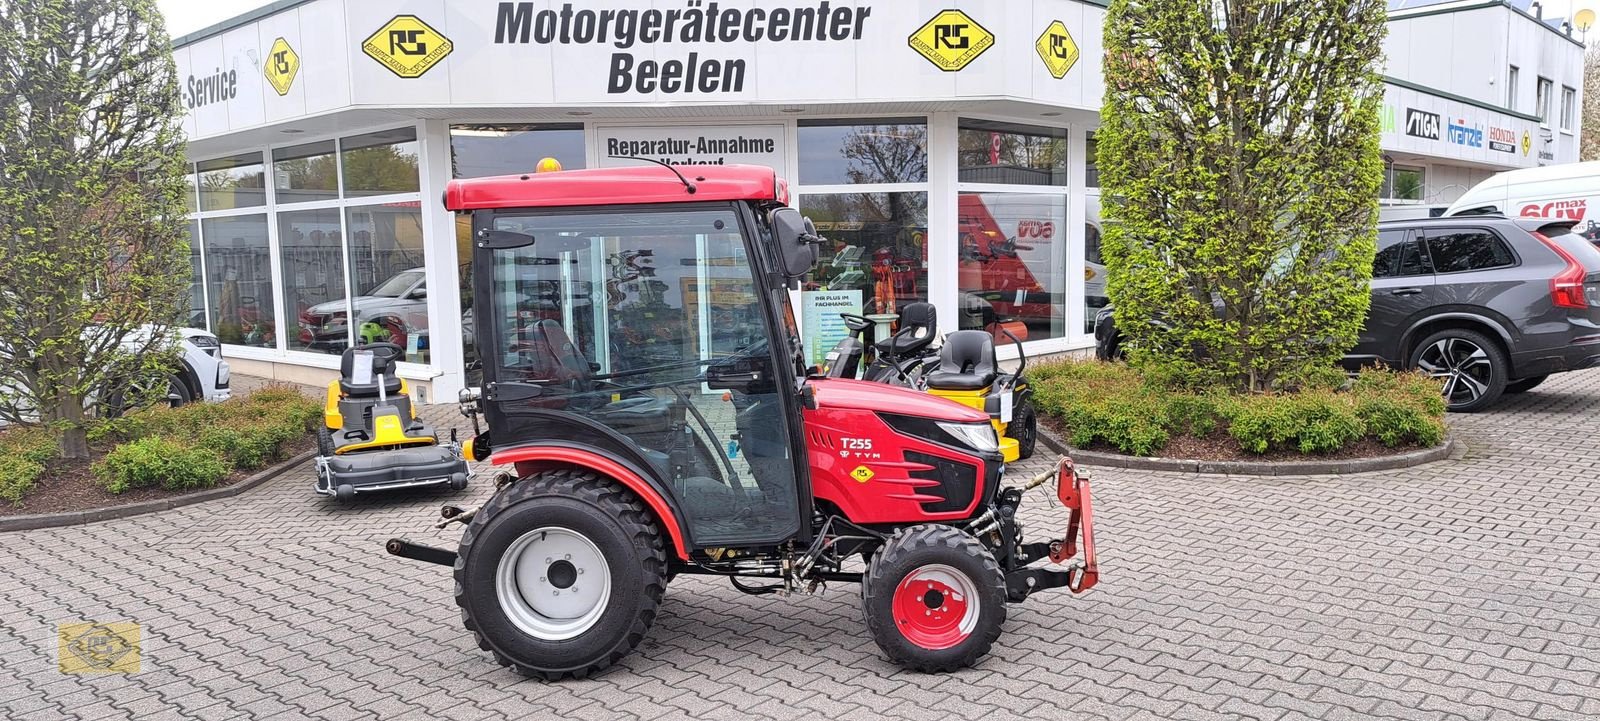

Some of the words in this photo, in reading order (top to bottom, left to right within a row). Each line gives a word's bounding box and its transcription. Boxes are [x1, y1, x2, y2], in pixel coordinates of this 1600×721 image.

[494, 0, 871, 48] Motorgerätecenter
[607, 52, 746, 94] Beelen
[182, 67, 237, 109] -Service
[1407, 110, 1439, 139] STIGA
[1489, 126, 1516, 144] HONDA
[607, 136, 775, 156] Reparatur-Annahme
[1556, 199, 1586, 208] max
[840, 437, 872, 450] T255
